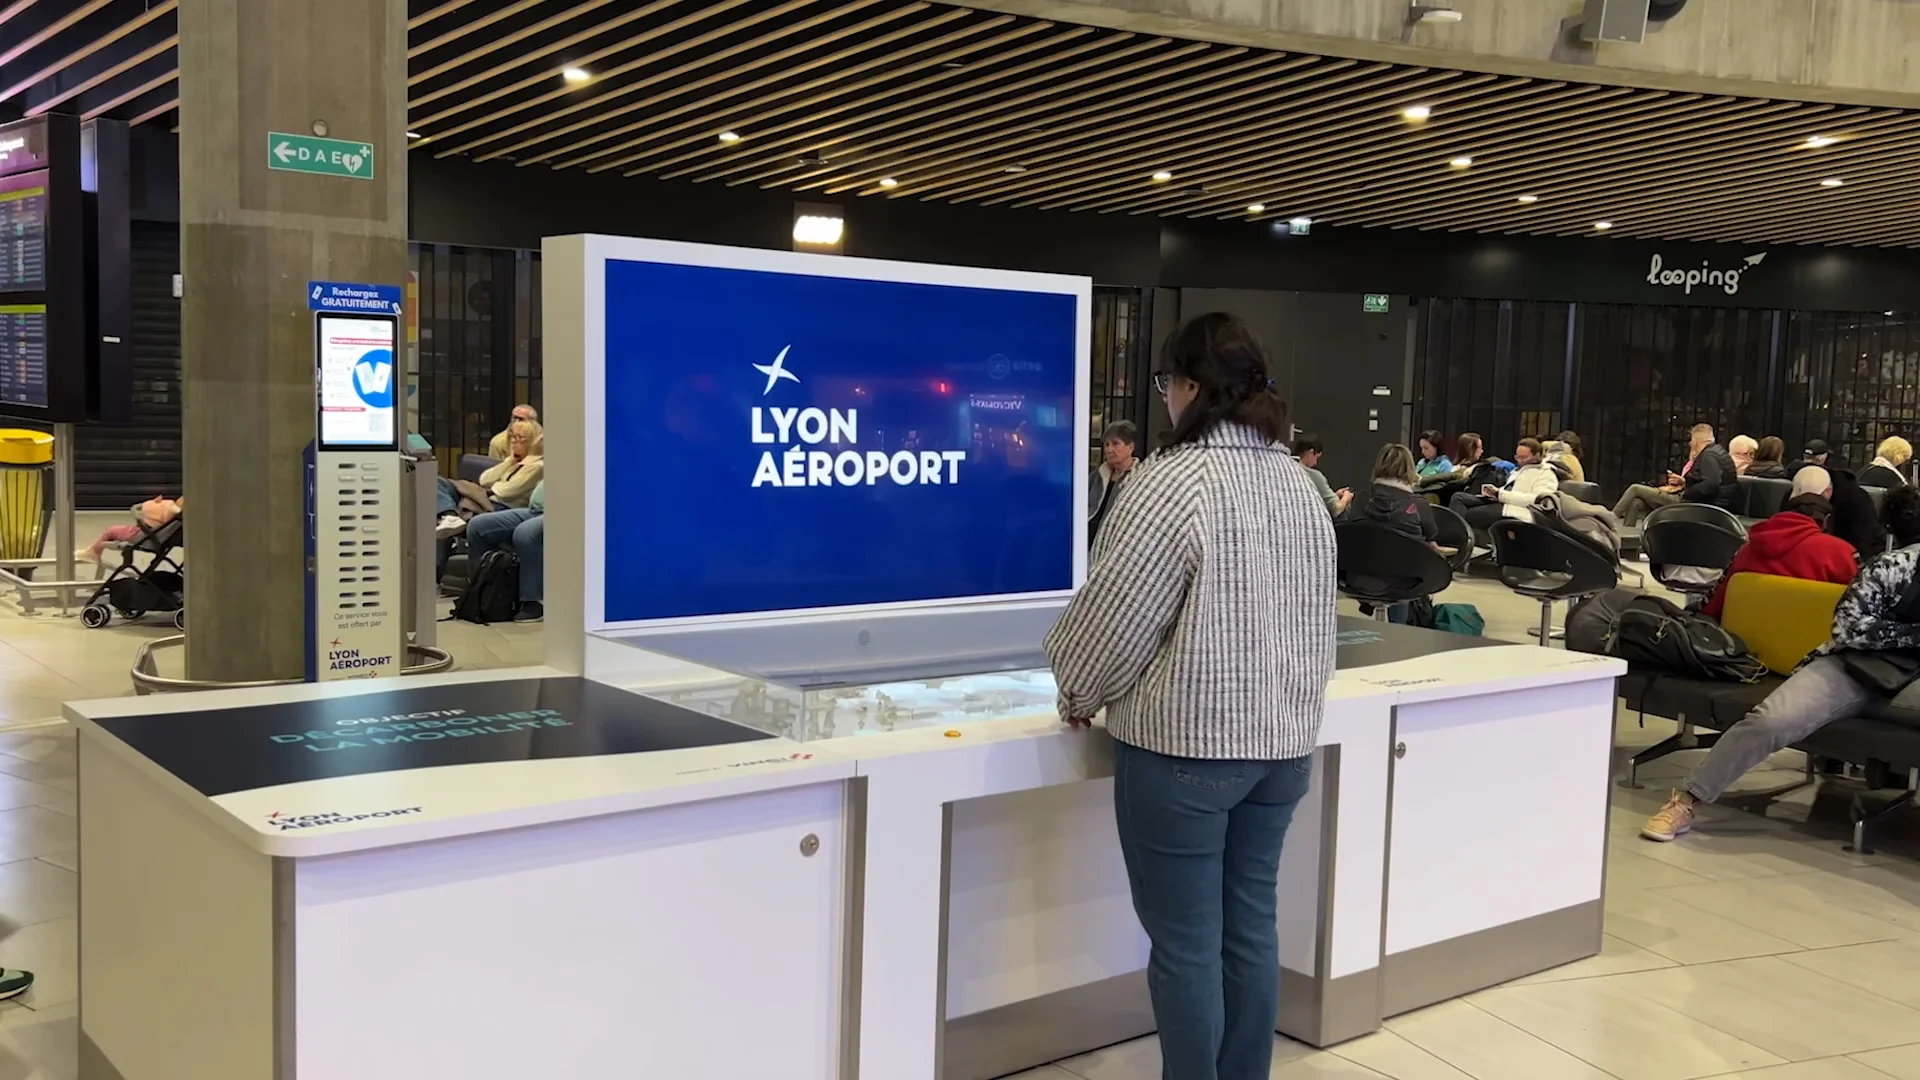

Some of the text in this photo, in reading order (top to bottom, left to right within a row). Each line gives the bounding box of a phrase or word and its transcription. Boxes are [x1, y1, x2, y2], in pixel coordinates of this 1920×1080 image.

[298, 147, 342, 165] DAE
[1646, 253, 1739, 295] looping
[332, 287, 379, 299] Rechargez
[321, 297, 389, 309] GRATUITEMENT
[751, 406, 858, 444] LYON
[751, 444, 966, 487] AÉROPORT
[333, 610, 388, 620] Ce service vous
[338, 620, 382, 629] est offert par
[329, 649, 359, 660] LYON
[269, 708, 562, 744] DÉCARBONER
[335, 708, 467, 726] OBJECTIF
[304, 717, 574, 752] LA MOBILITÉ
[268, 811, 341, 825] LYON
